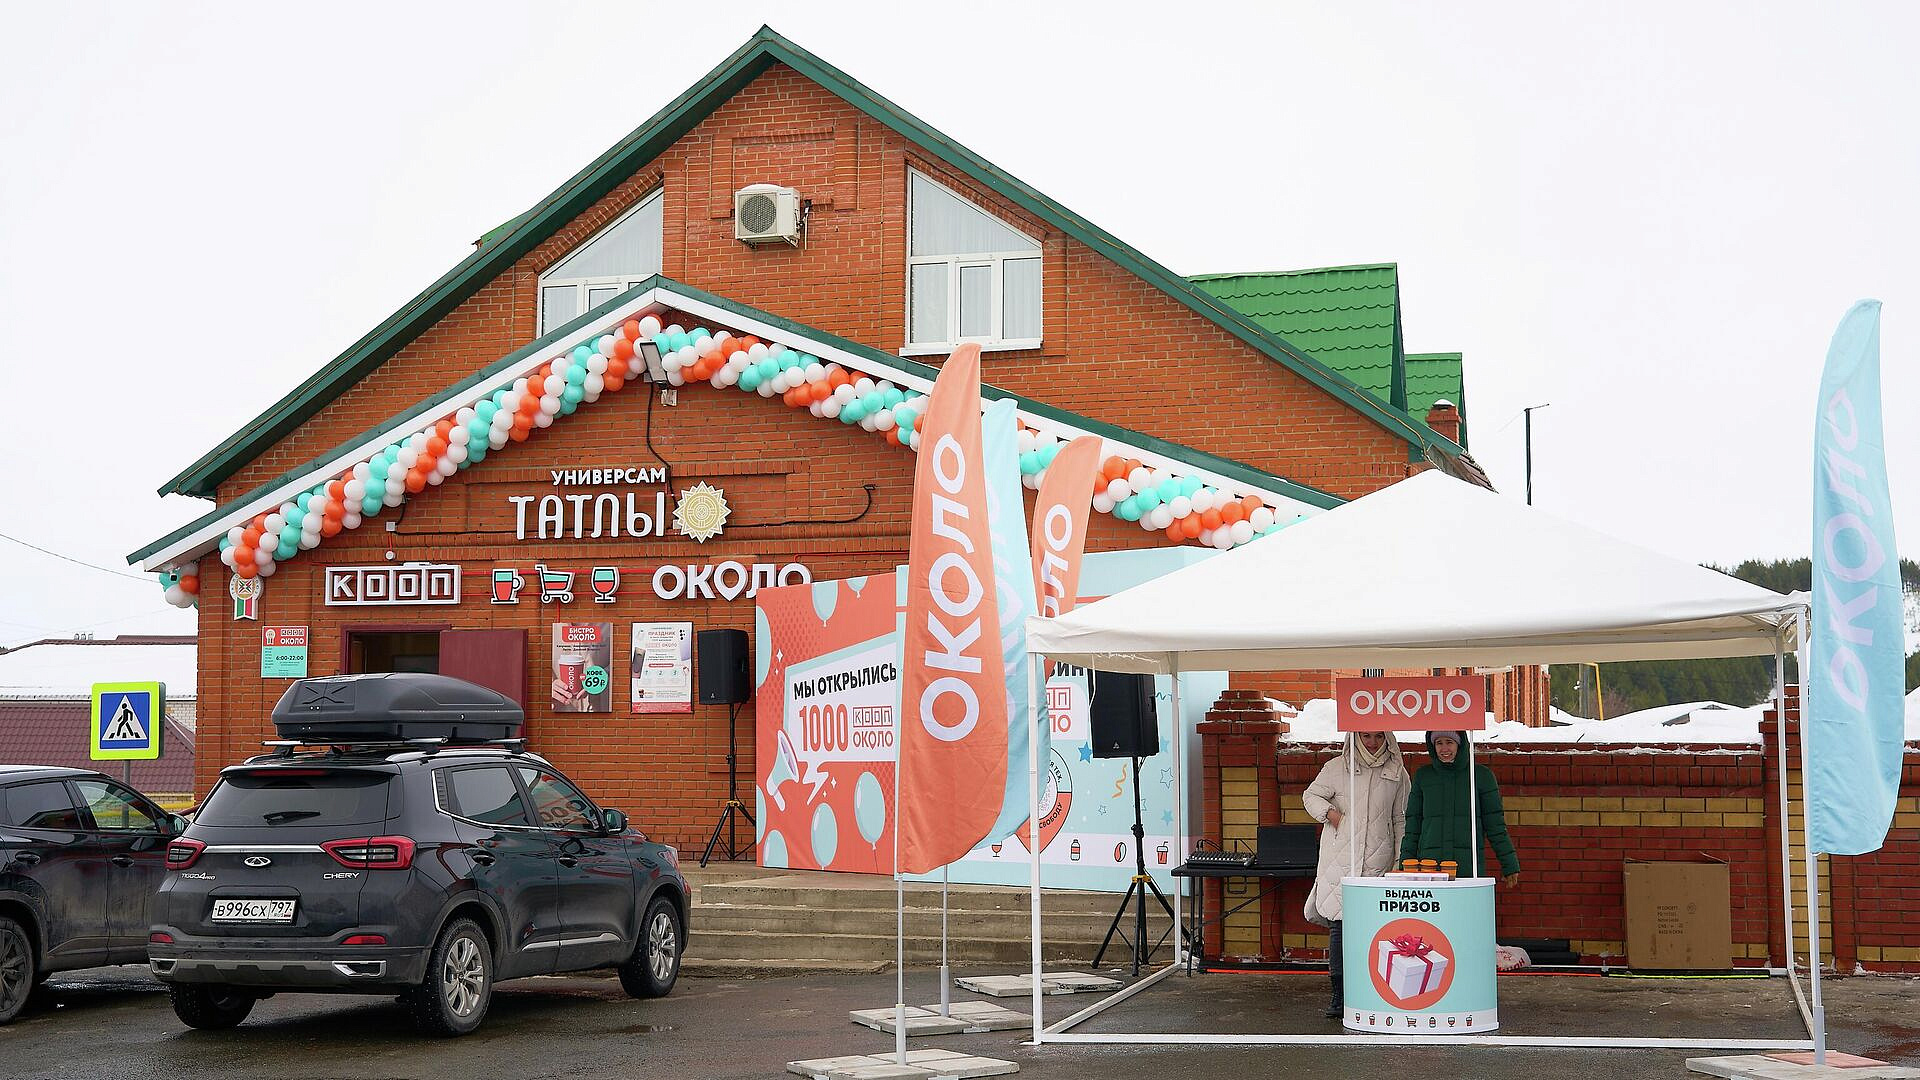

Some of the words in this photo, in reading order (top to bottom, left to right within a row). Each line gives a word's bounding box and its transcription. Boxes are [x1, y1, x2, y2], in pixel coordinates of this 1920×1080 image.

[551, 467, 666, 486] УНИВЕРСАМ
[508, 491, 665, 540] ТАТЛЫ
[1041, 504, 1072, 618] ЛО
[329, 569, 456, 601] КООП
[652, 560, 813, 601] ОКОЛО
[919, 432, 983, 742] ОКОЛО
[280, 637, 305, 645] ОКОЛО
[568, 633, 596, 641] ОКОЛО
[793, 679, 815, 700] МЫ
[817, 663, 897, 695] ОТКРЫЛИСЬ
[854, 709, 891, 725] КООП
[1350, 689, 1471, 718] ОКОЛО
[799, 704, 848, 752] 1000
[853, 730, 893, 750] ОКОЛО
[1379, 900, 1441, 913] ПРИЗОВ
[1385, 889, 1433, 900] ВЫДАЧА
